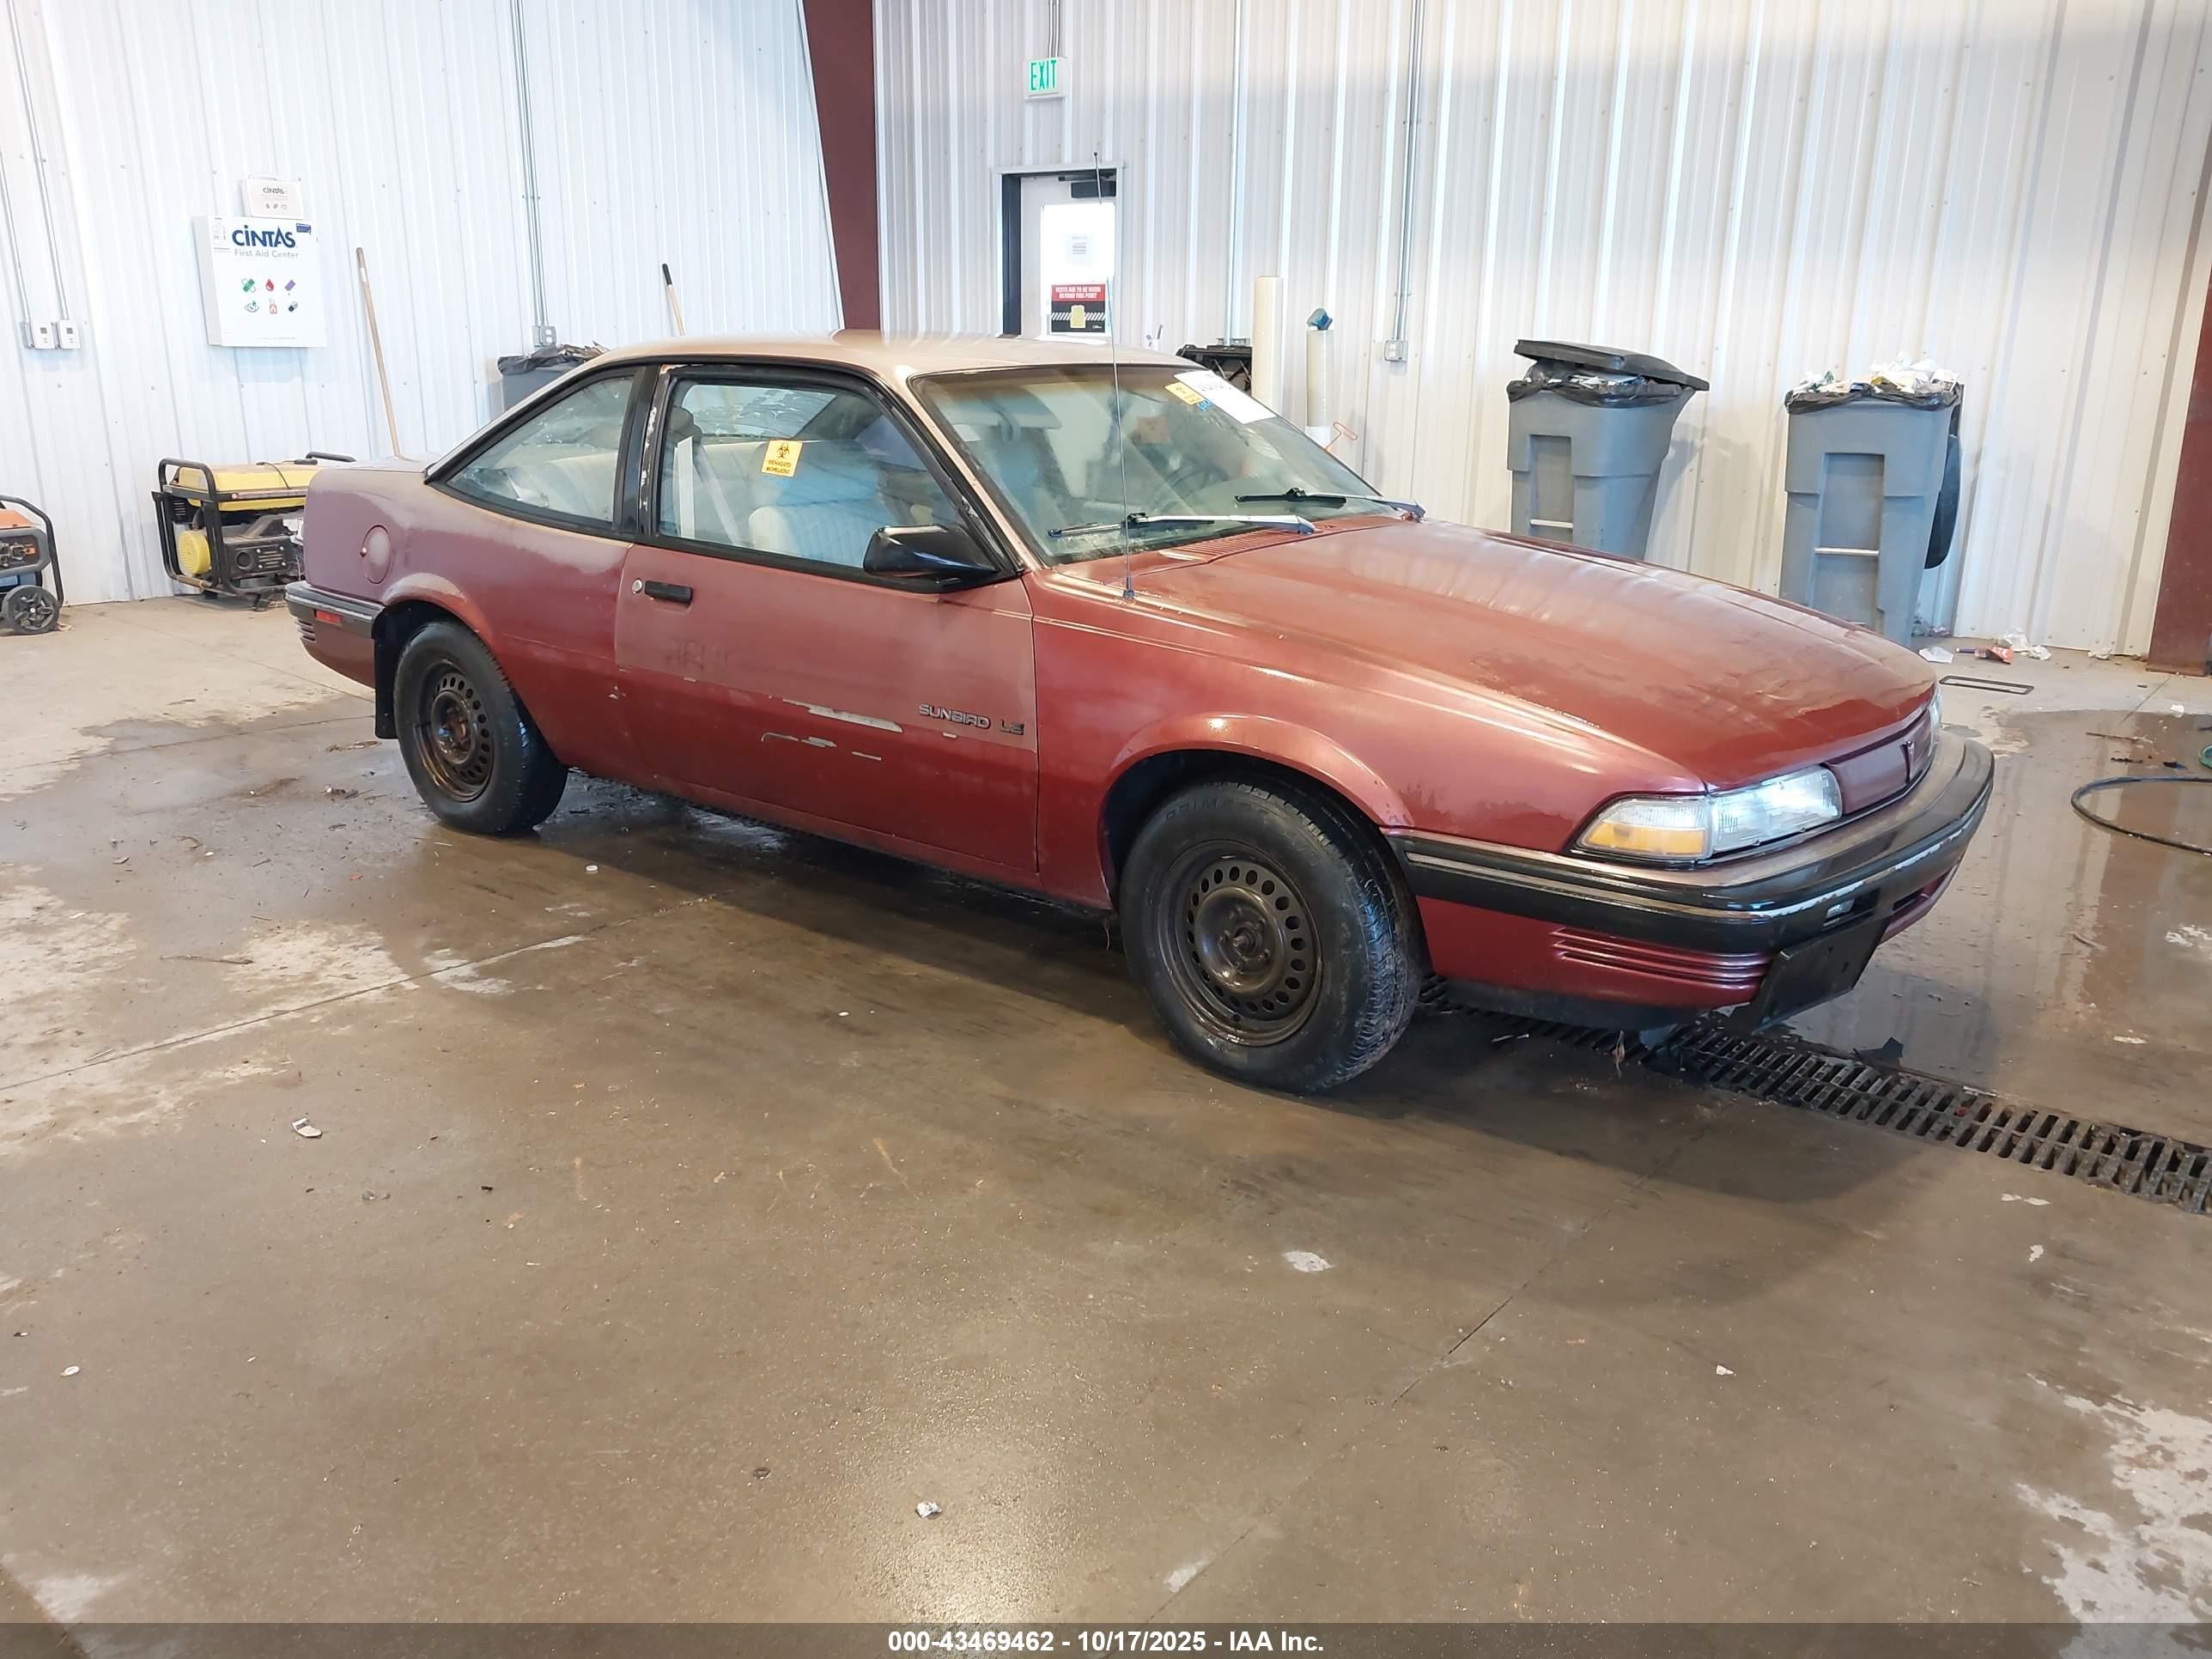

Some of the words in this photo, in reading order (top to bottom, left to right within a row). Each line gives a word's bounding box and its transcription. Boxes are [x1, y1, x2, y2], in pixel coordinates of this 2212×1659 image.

[1030, 59, 1057, 91] EXIT
[256, 249, 270, 258] Aid
[271, 250, 299, 258] Center
[918, 703, 991, 729] SUNBIRD
[1000, 719, 1024, 736] LE
